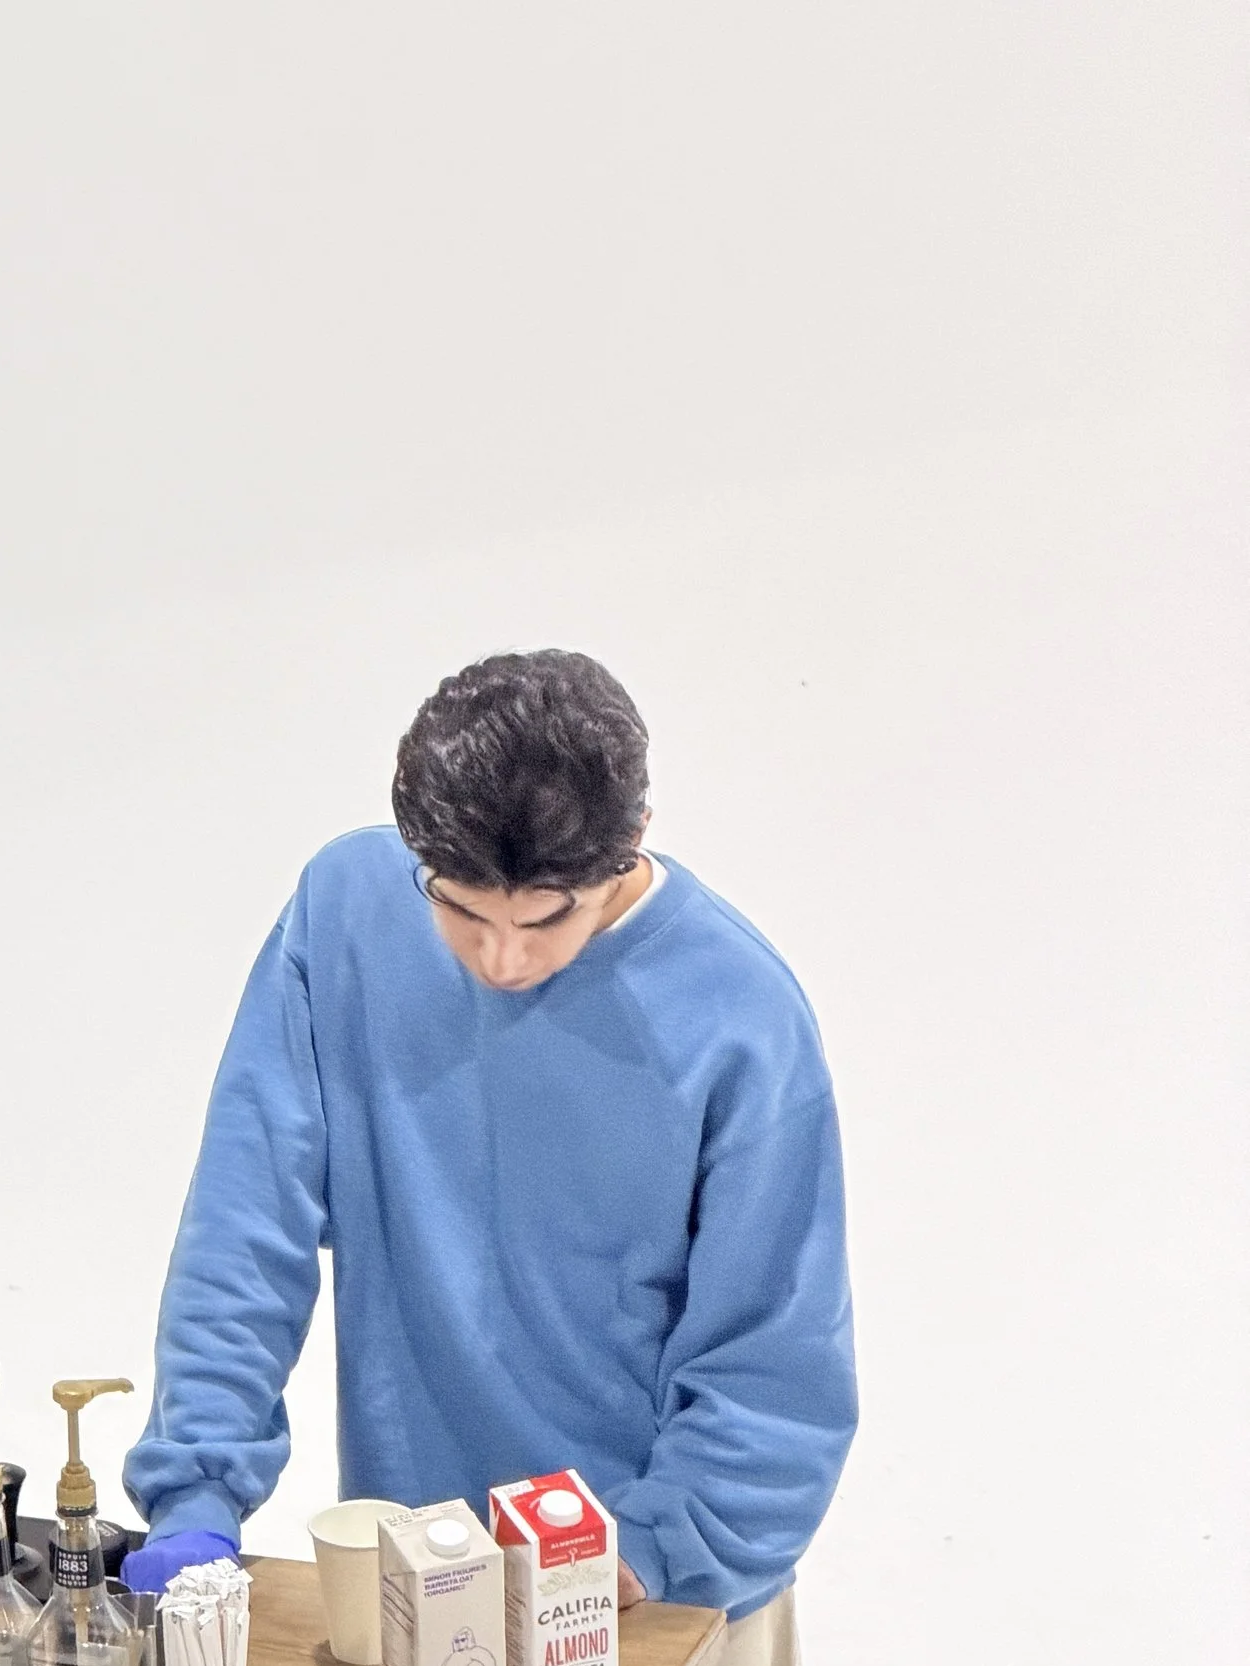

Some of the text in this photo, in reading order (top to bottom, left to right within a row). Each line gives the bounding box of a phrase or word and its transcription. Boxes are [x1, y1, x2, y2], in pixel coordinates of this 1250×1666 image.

[58, 1558, 88, 1573] 1883
[424, 1564, 487, 1583] MINOR FIGURES
[424, 1574, 474, 1591] BARISTA OAT
[537, 1595, 613, 1626] CALIFIA
